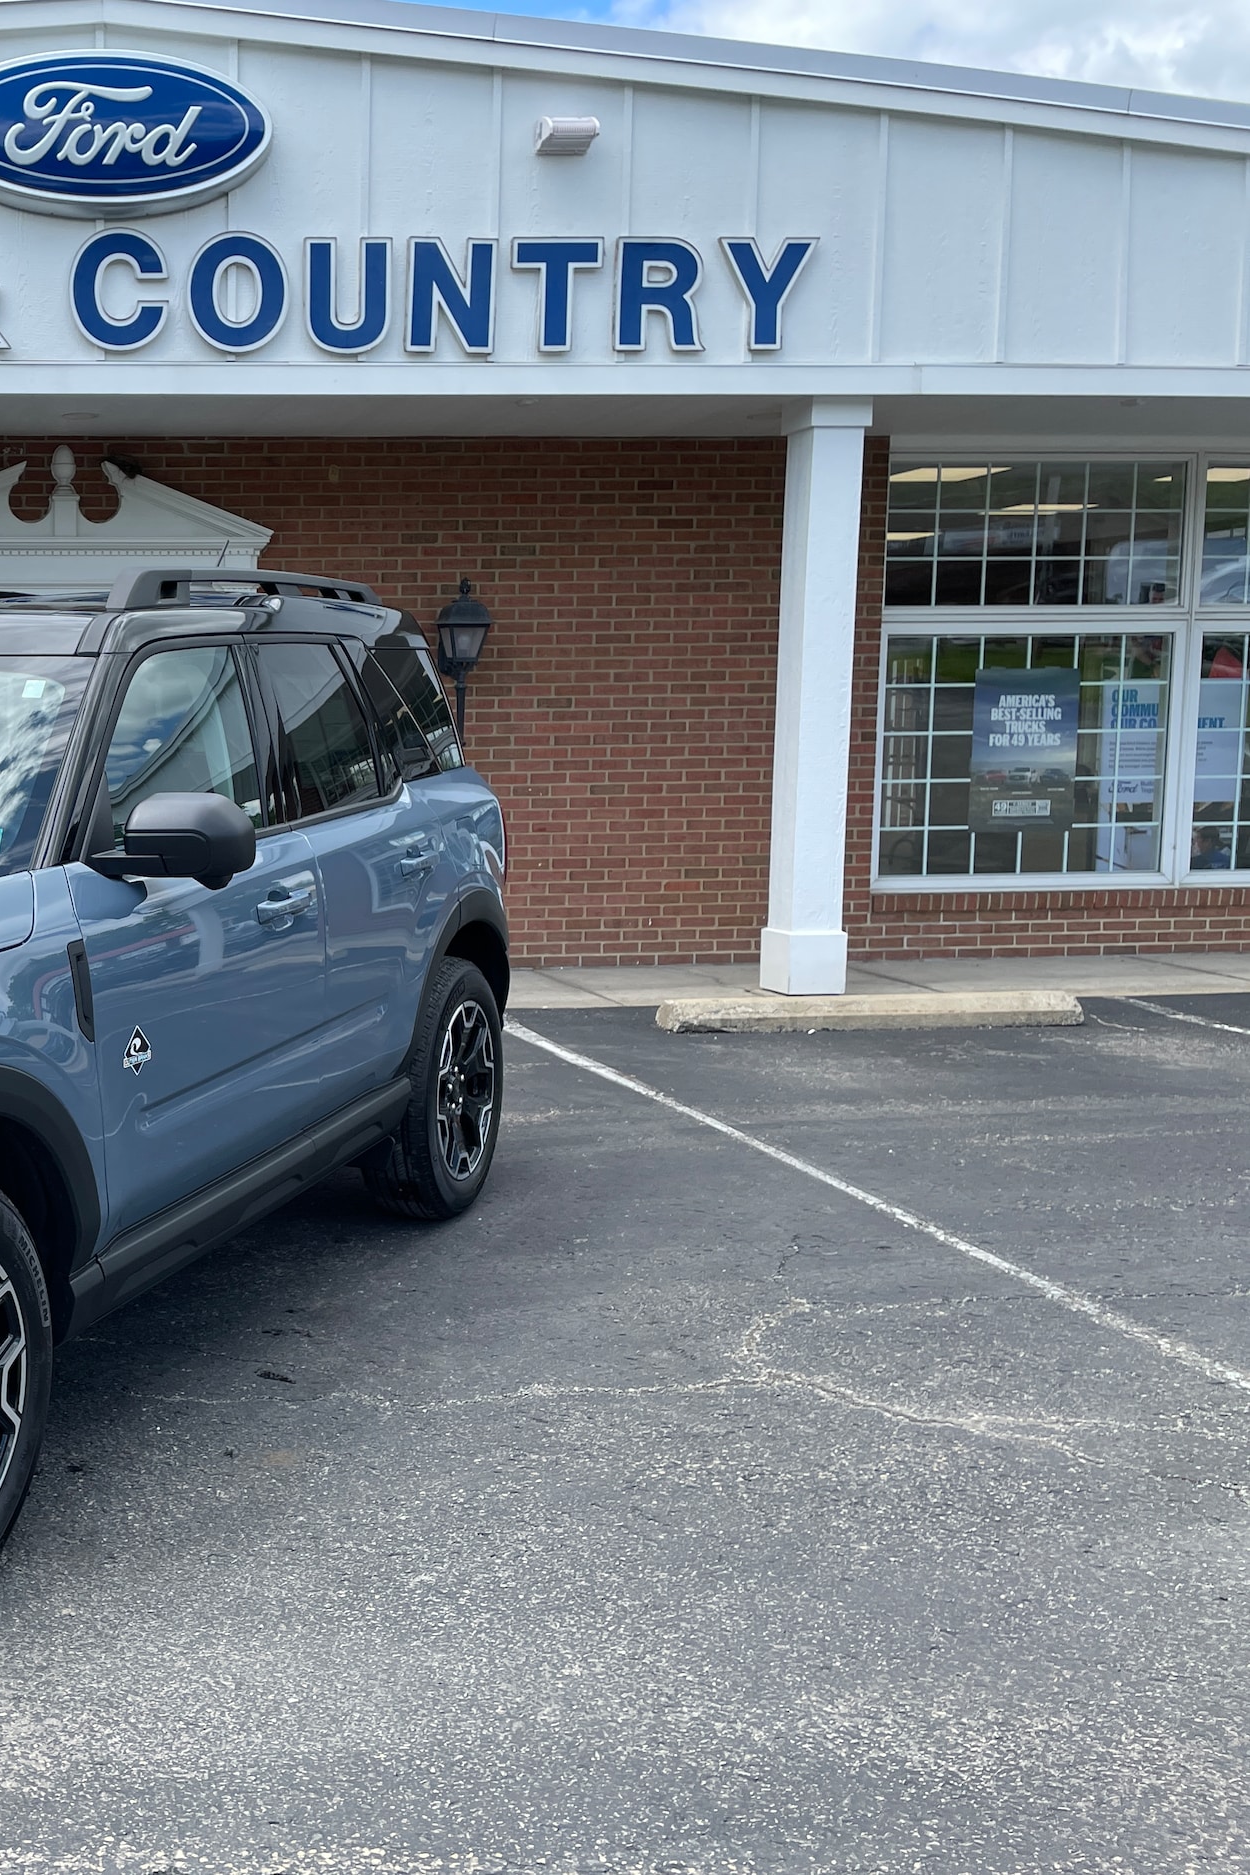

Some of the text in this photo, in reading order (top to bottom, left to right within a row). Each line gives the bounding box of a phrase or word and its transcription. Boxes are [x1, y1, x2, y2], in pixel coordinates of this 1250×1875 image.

[3, 80, 201, 168] Ford
[68, 227, 820, 355] COUNTRY
[998, 694, 1056, 708] AMERICA'S
[1111, 689, 1139, 703] OUR
[990, 707, 1062, 721] BEST-SELLING
[1111, 703, 1159, 717] COMMU
[1004, 720, 1046, 734] TRUCKS
[989, 733, 1062, 747] FOR 49 YEARS
[17, 1235, 50, 1322] MICHELIN
